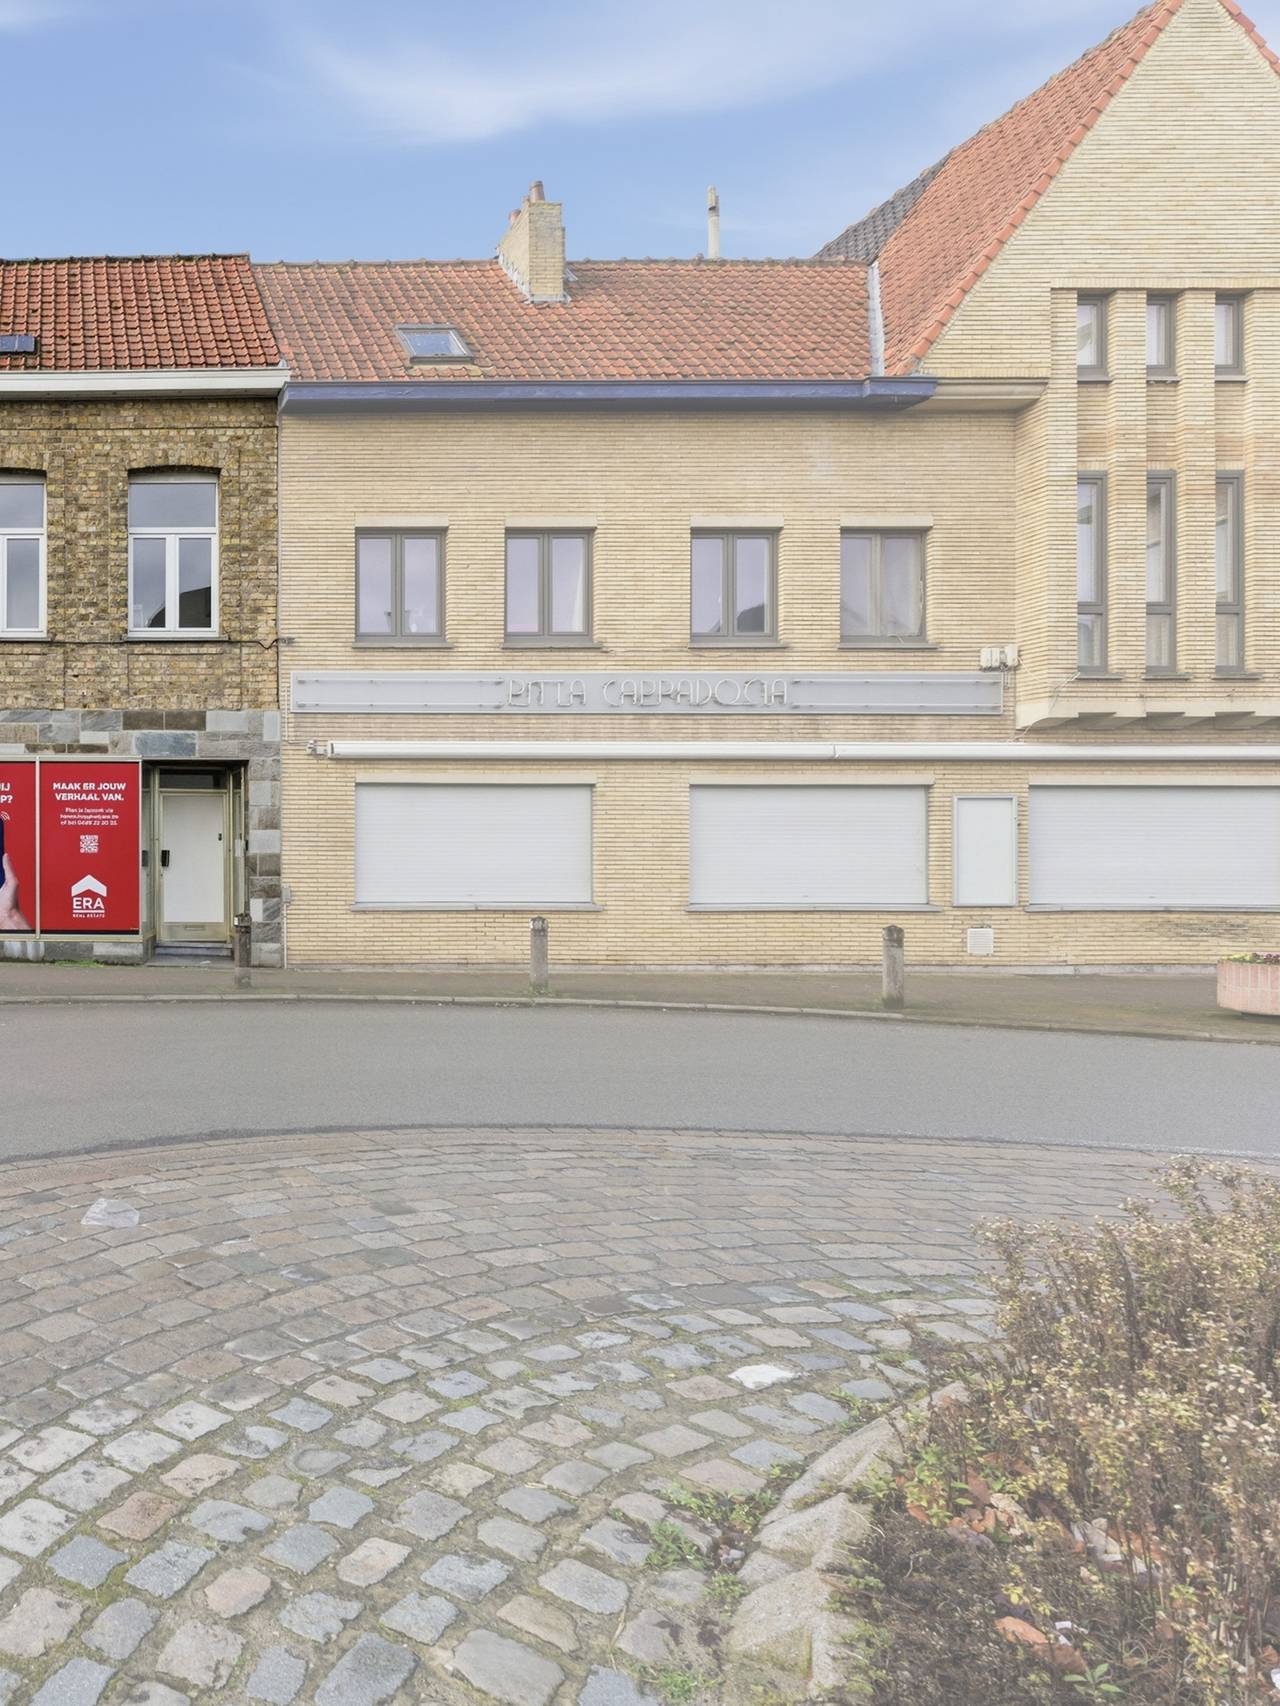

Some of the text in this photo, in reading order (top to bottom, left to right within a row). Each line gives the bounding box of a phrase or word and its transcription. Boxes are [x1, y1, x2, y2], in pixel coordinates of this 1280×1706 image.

[52, 782, 127, 790] MAAK ER JOUW
[55, 793, 125, 801] VERHAAL VAN.
[72, 897, 105, 909] ERA
